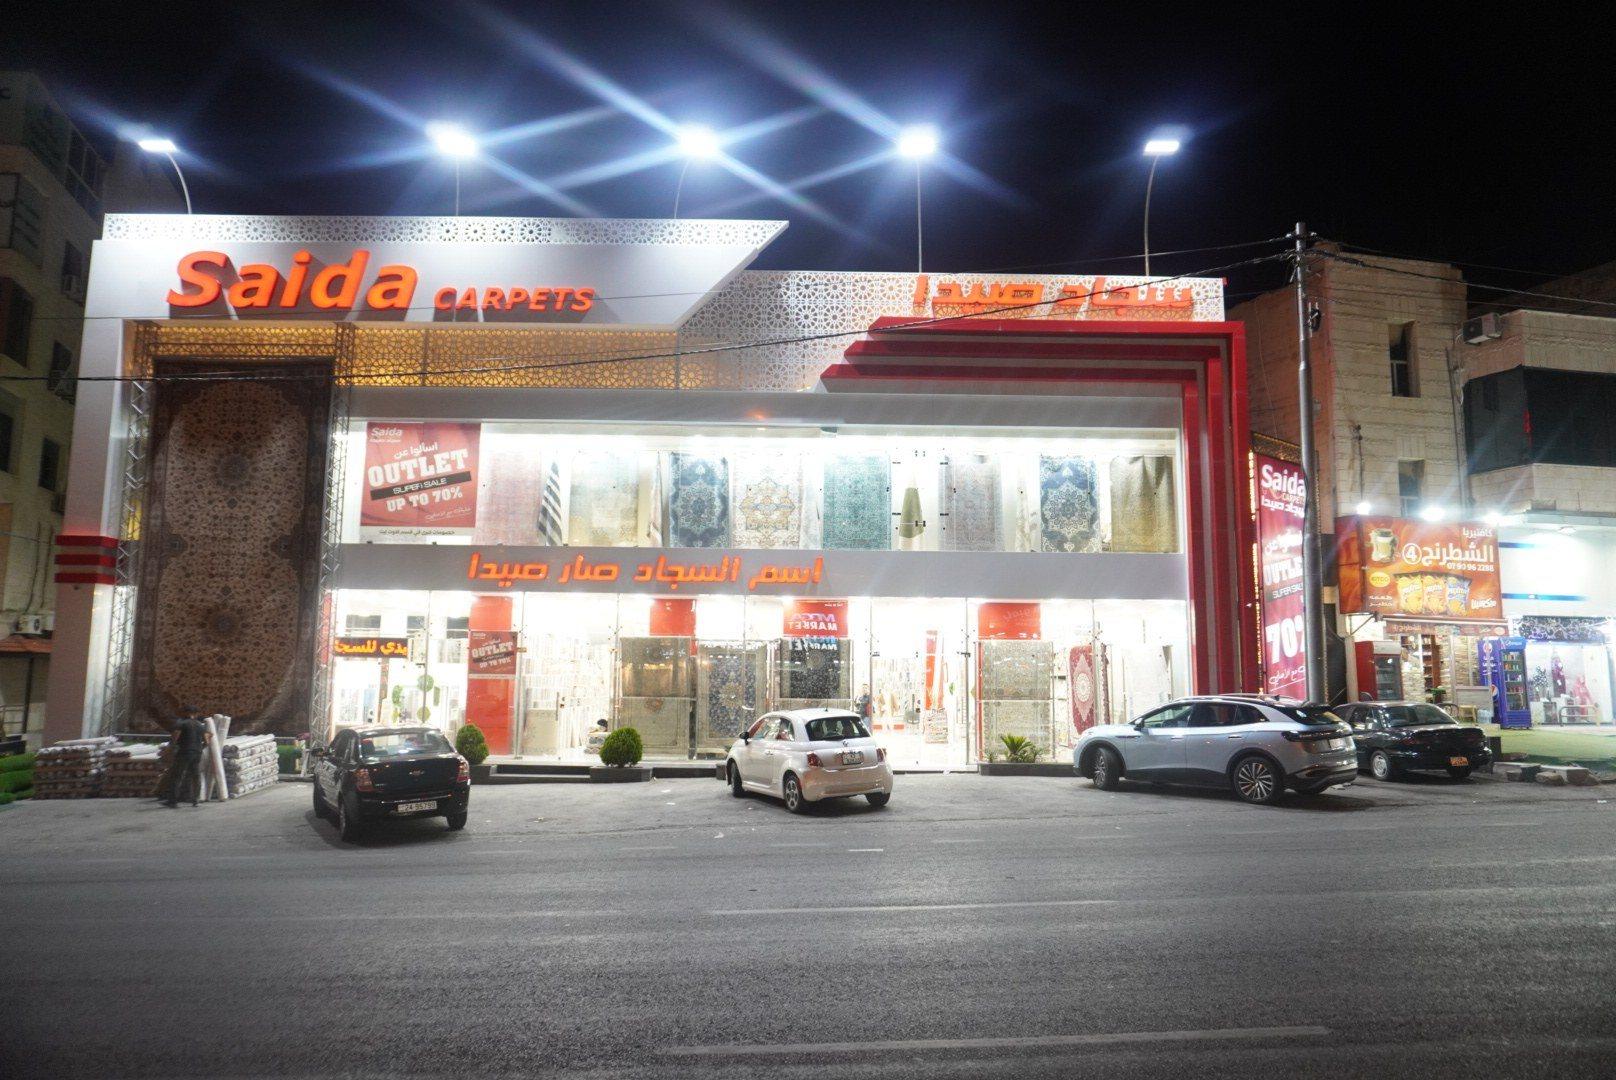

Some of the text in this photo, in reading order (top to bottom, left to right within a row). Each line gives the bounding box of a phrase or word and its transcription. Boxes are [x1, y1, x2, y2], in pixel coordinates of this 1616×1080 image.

[167, 249, 597, 313] Saida CARPETS
[912, 273, 1194, 316] سجاد صيدا
[371, 427, 403, 437] Saida
[367, 448, 469, 487] OUTLET
[393, 477, 448, 495] SUPER SALE
[1261, 464, 1306, 496] Saida
[386, 486, 463, 512] UP TO 70%
[1261, 495, 1284, 511] صيدا
[1282, 492, 1305, 504] CARPET
[1404, 542, 1495, 566] الشطرنج 4
[467, 551, 825, 591] اسم السجاد صار صيدا
[1263, 556, 1304, 587] OUTLE
[1272, 587, 1292, 599] SUPER
[472, 641, 513, 658] OUTLET
[479, 661, 488, 669] UP
